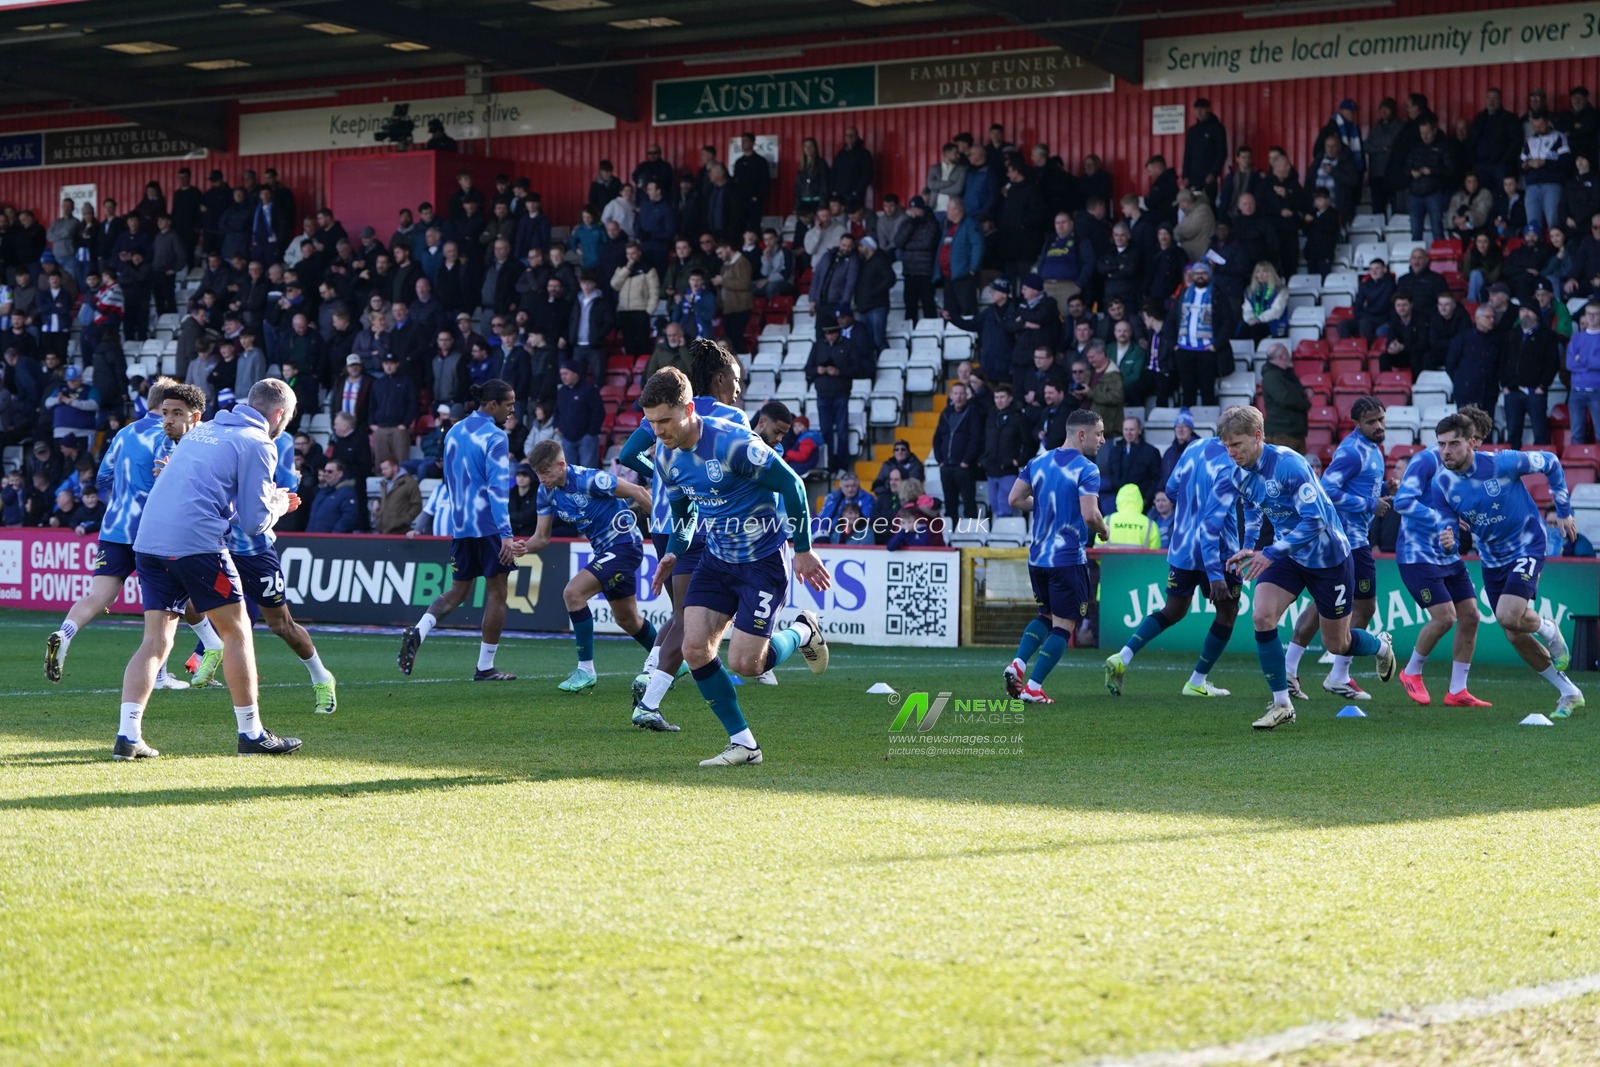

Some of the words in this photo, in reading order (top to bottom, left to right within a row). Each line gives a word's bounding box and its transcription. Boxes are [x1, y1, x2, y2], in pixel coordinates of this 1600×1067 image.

[1166, 45, 1241, 73] Serving
[1250, 39, 1283, 64] the
[1291, 34, 1341, 61] local
[1348, 26, 1472, 56] community
[1480, 20, 1512, 52] for
[1521, 21, 1571, 44] over
[1579, 12, 1600, 39] 3
[910, 61, 981, 81] FAMILY
[992, 55, 1085, 75] FUNERAL
[694, 76, 835, 114] AUSTIN'S
[938, 74, 1055, 96] DIRECTORS
[399, 106, 475, 129] emories
[53, 143, 124, 160] MEMORIAL
[30, 540, 81, 570] GAME
[1512, 557, 1537, 577] 21
[260, 570, 284, 598] 26
[1334, 584, 1347, 607] 2
[753, 590, 773, 619] 3
